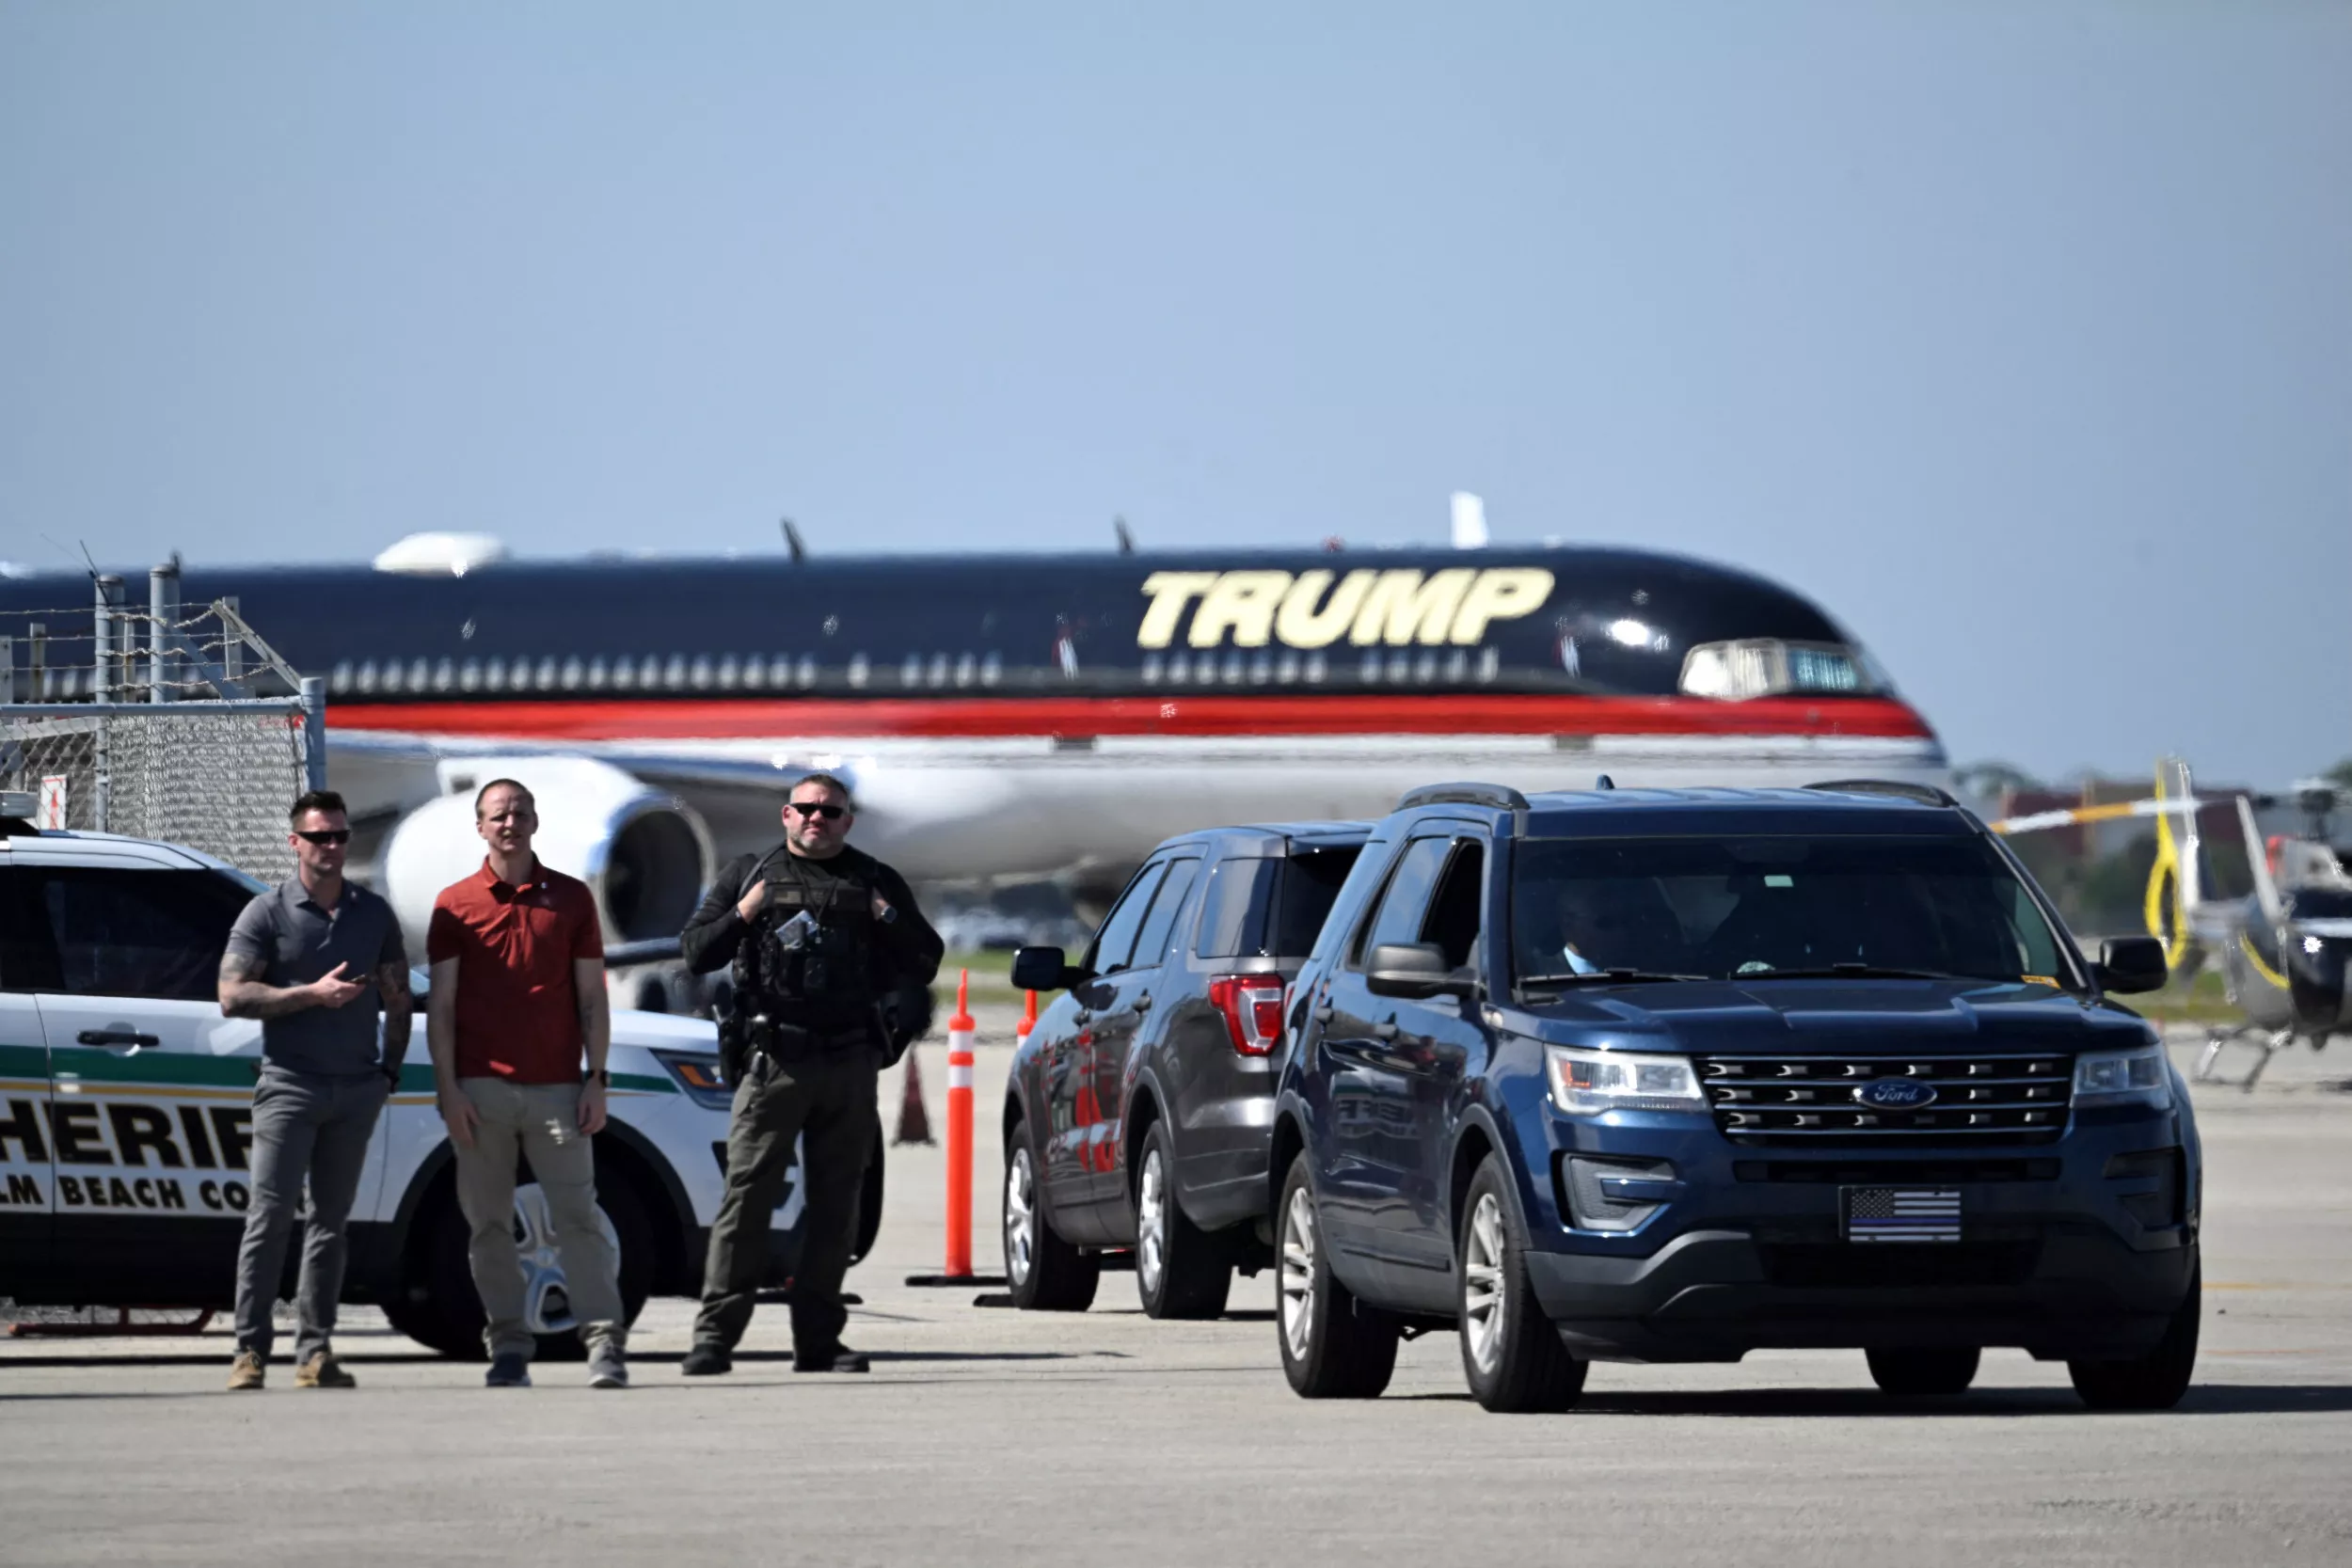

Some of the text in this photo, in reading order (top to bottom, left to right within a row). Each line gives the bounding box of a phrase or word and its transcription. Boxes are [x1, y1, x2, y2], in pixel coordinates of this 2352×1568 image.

[1137, 568, 1555, 648] TRUMP
[1874, 1084, 1918, 1101] Ford
[58, 1176, 185, 1209] BEACH
